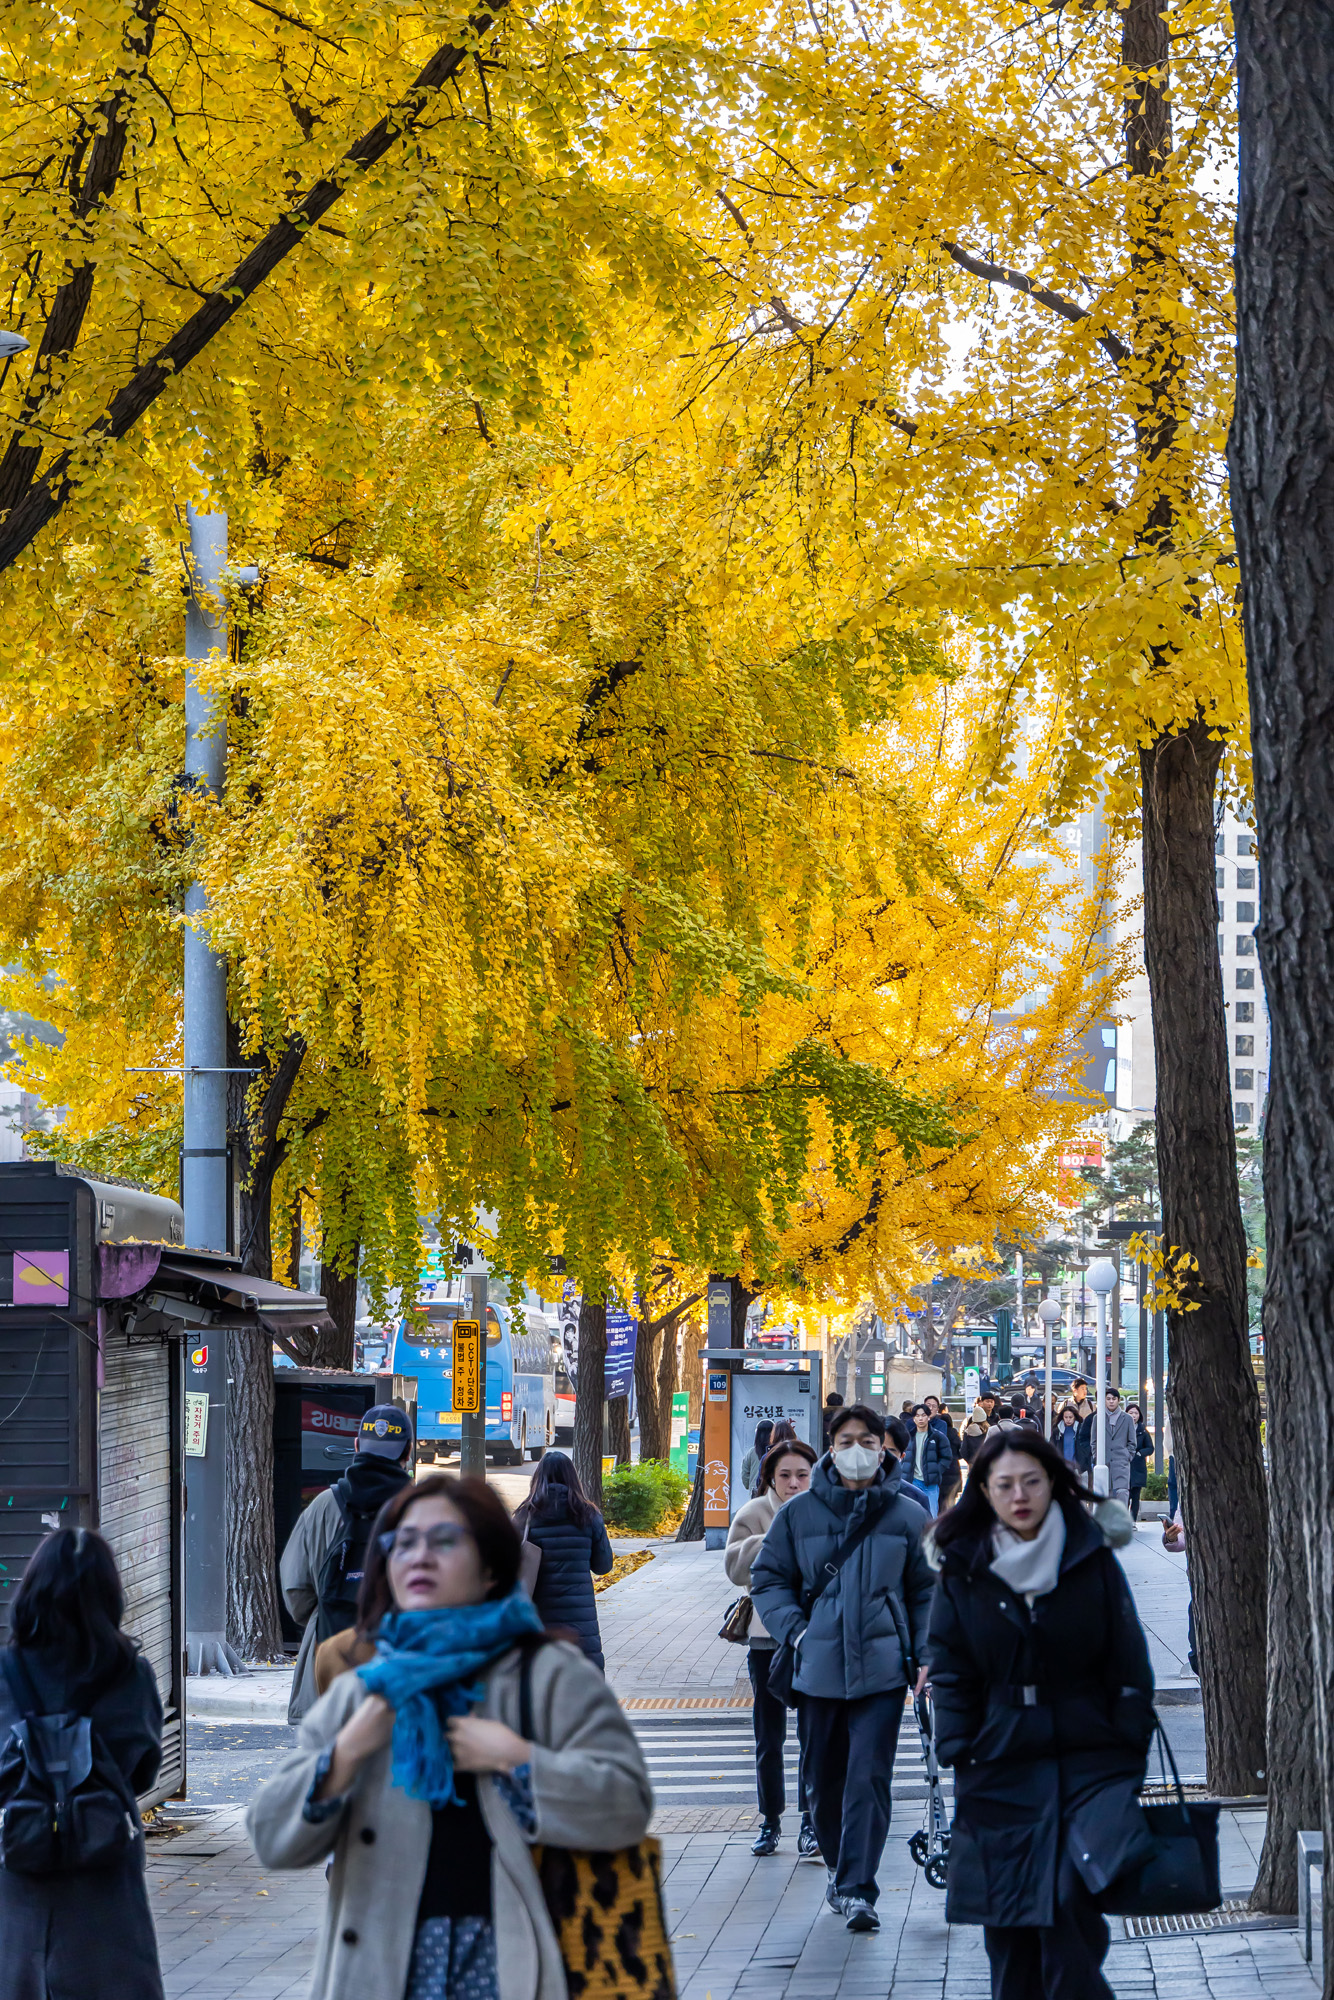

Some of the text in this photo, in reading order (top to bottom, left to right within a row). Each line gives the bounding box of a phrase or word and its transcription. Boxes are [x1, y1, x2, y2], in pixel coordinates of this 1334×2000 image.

[457, 1342, 465, 1362] 불법
[713, 1381, 727, 1389] 109
[194, 1407, 202, 1429] 자전거
[744, 1405, 785, 1418] 임금님표
[192, 1430, 200, 1446] 주의
